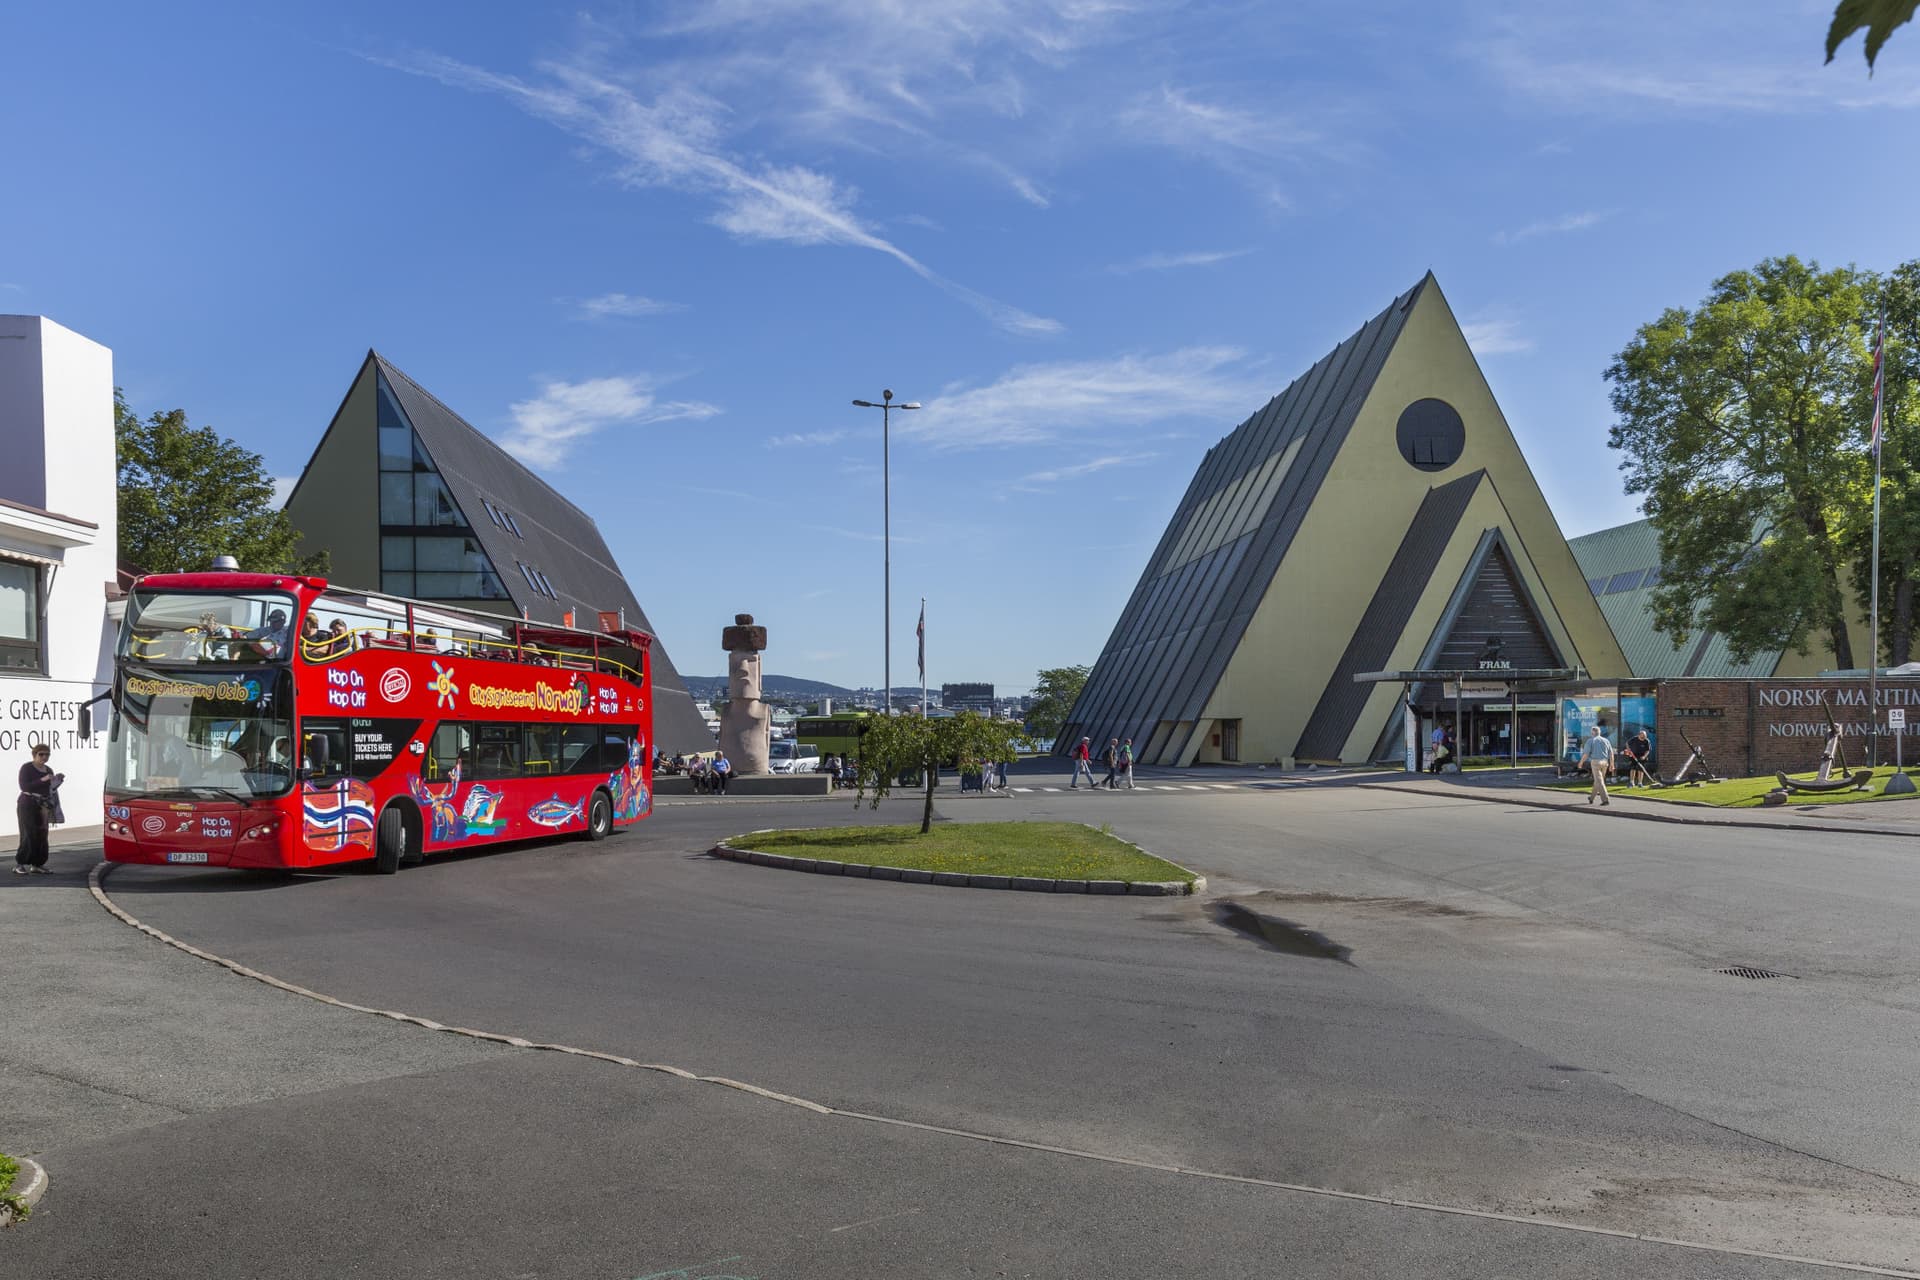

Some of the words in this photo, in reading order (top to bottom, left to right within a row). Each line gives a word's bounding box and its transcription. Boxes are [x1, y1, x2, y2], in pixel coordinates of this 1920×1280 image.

[1480, 661, 1510, 669] FRAM
[328, 668, 348, 687] Hop
[350, 670, 364, 687] On
[216, 681, 248, 701] Oslo
[599, 687, 610, 700] Hop
[1759, 688, 1829, 706] NORSK
[329, 689, 349, 708] Hop
[350, 690, 367, 707] Off
[536, 680, 582, 716] Norway
[600, 702, 610, 714] Hop
[1769, 723, 1867, 737] NORWEAN
[0, 730, 20, 750] OF
[28, 730, 60, 750] OUR
[354, 733, 367, 742] BUY
[367, 733, 383, 742] YOUR
[354, 743, 377, 752] TICKETS
[378, 743, 393, 752] HERE
[202, 817, 218, 826] Hop
[219, 817, 231, 826] On
[202, 828, 219, 837] Hop
[220, 828, 232, 837] Off
